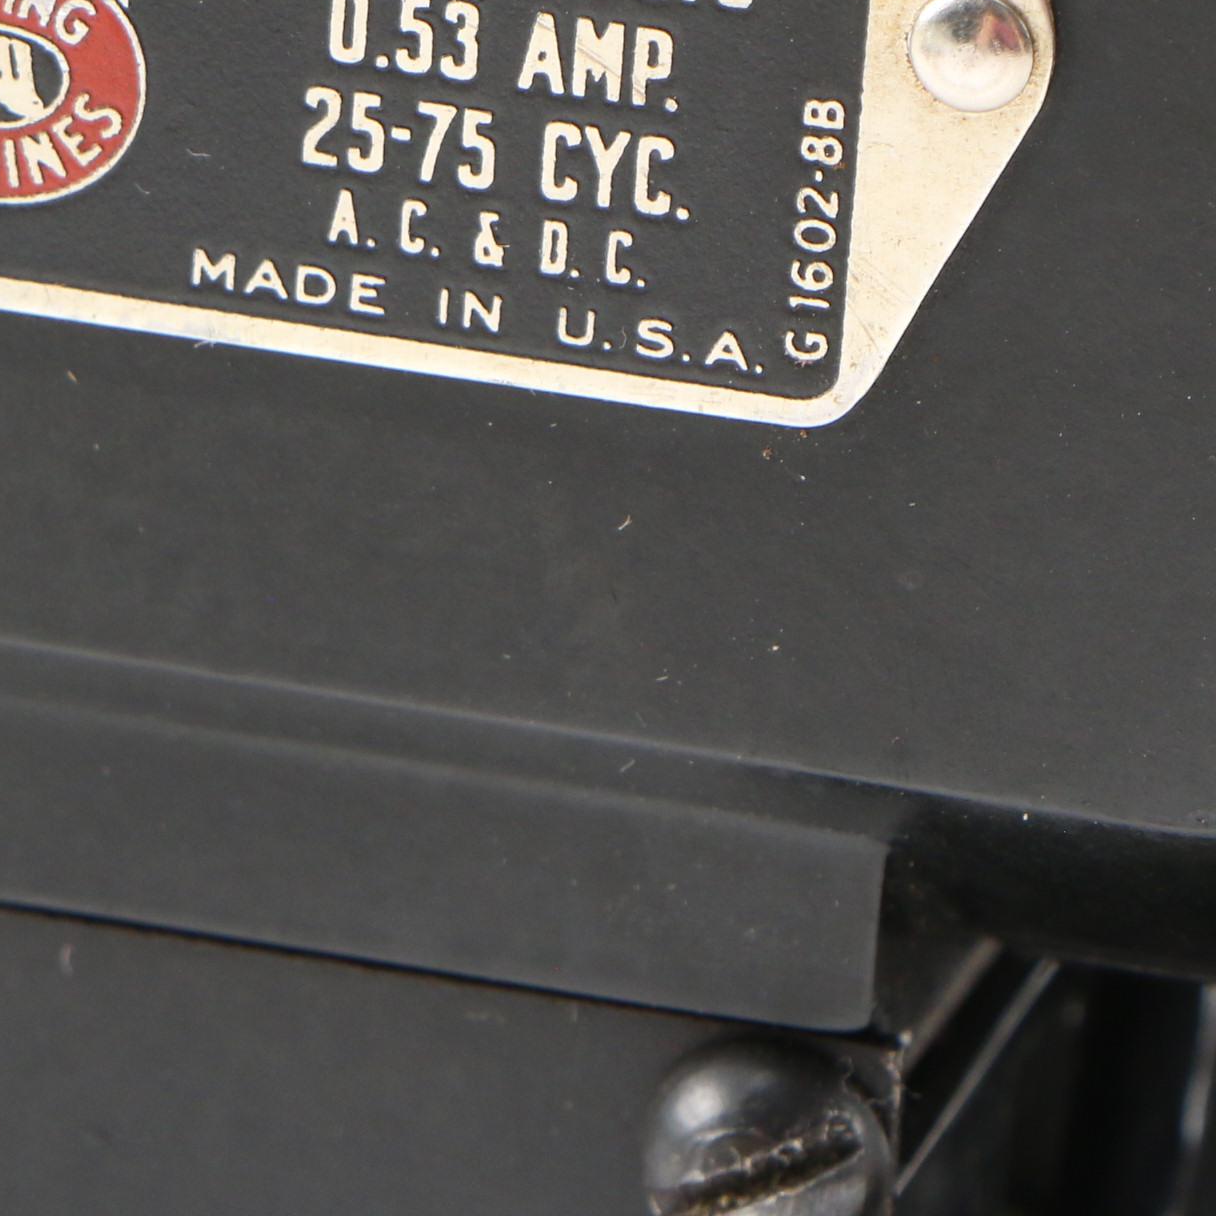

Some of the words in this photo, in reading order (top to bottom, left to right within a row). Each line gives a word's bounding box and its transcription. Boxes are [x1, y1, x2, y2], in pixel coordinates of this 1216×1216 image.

[517, 12, 677, 112] AMP.
[302, 87, 495, 189] 25-75
[540, 123, 689, 220] CYC.
[473, 212, 506, 267] &
[192, 249, 385, 314] MADE
[438, 289, 502, 332] IN
